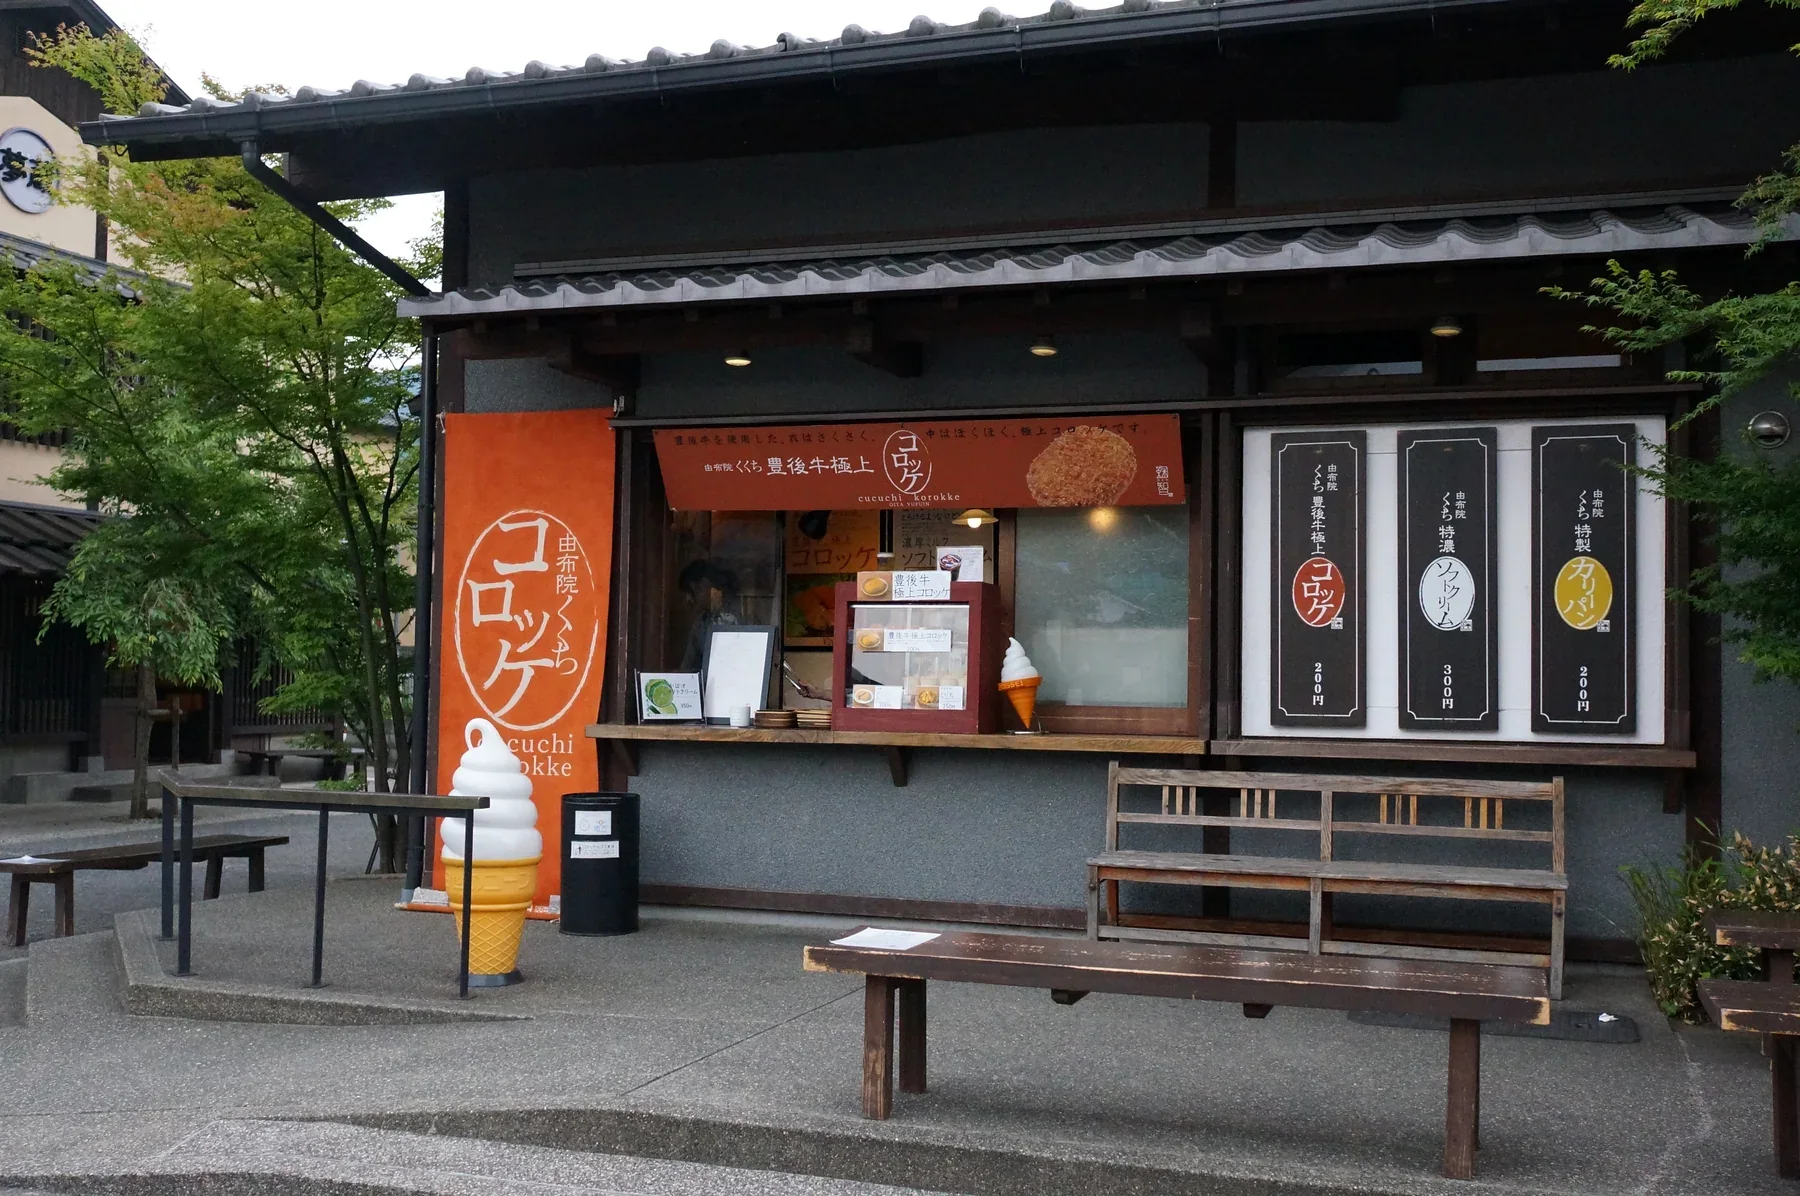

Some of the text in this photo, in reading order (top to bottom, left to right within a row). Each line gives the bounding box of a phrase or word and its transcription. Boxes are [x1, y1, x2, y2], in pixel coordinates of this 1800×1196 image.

[767, 456, 875, 476] 豊後牛極上
[891, 433, 923, 492] コロッケ
[1327, 464, 1338, 491] 由布院
[858, 493, 960, 502] cucuchi korokke
[1455, 491, 1467, 519] 由布院
[1592, 489, 1604, 518] 由布院
[1310, 496, 1326, 555] 豊後牛極上
[1439, 525, 1456, 553] 特濃
[1574, 524, 1592, 552] 特製
[791, 547, 876, 570] コロッケ
[893, 587, 949, 599] 極上コロッケ
[894, 574, 930, 587] 豊後牛
[1301, 562, 1335, 625] コロッケ
[1436, 561, 1461, 627] ソフトクリーム
[1563, 558, 1596, 627] カリーパン
[466, 517, 555, 719] コロッケ
[1312, 662, 1324, 706] 200円
[1442, 664, 1454, 709] 300円
[1577, 666, 1589, 712] 200円
